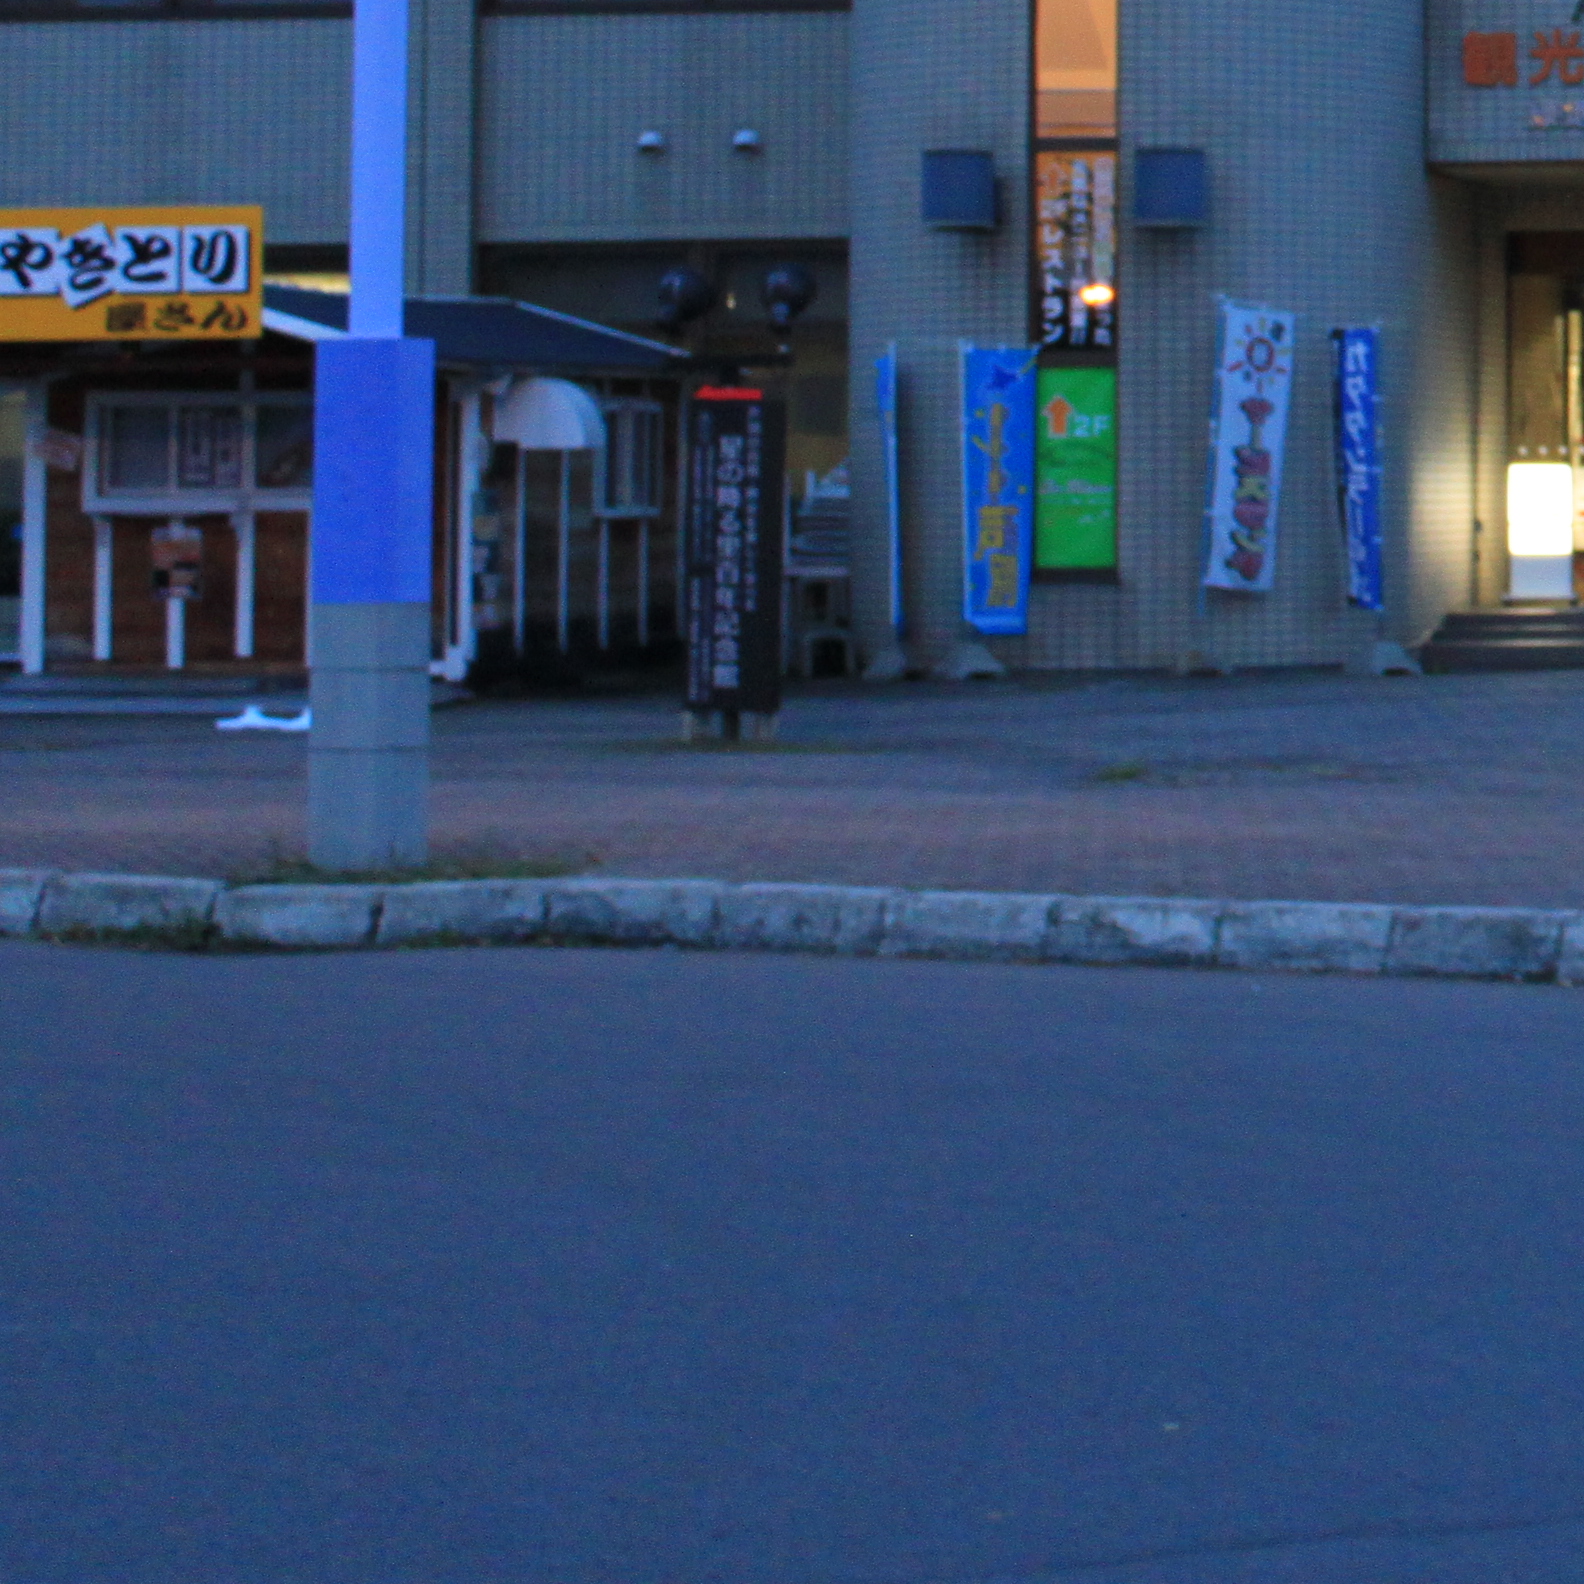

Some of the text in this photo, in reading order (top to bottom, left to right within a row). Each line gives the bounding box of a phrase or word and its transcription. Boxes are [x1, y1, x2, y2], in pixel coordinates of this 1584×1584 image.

[0, 230, 238, 290] やきとり
[1073, 413, 1110, 437] 2F
